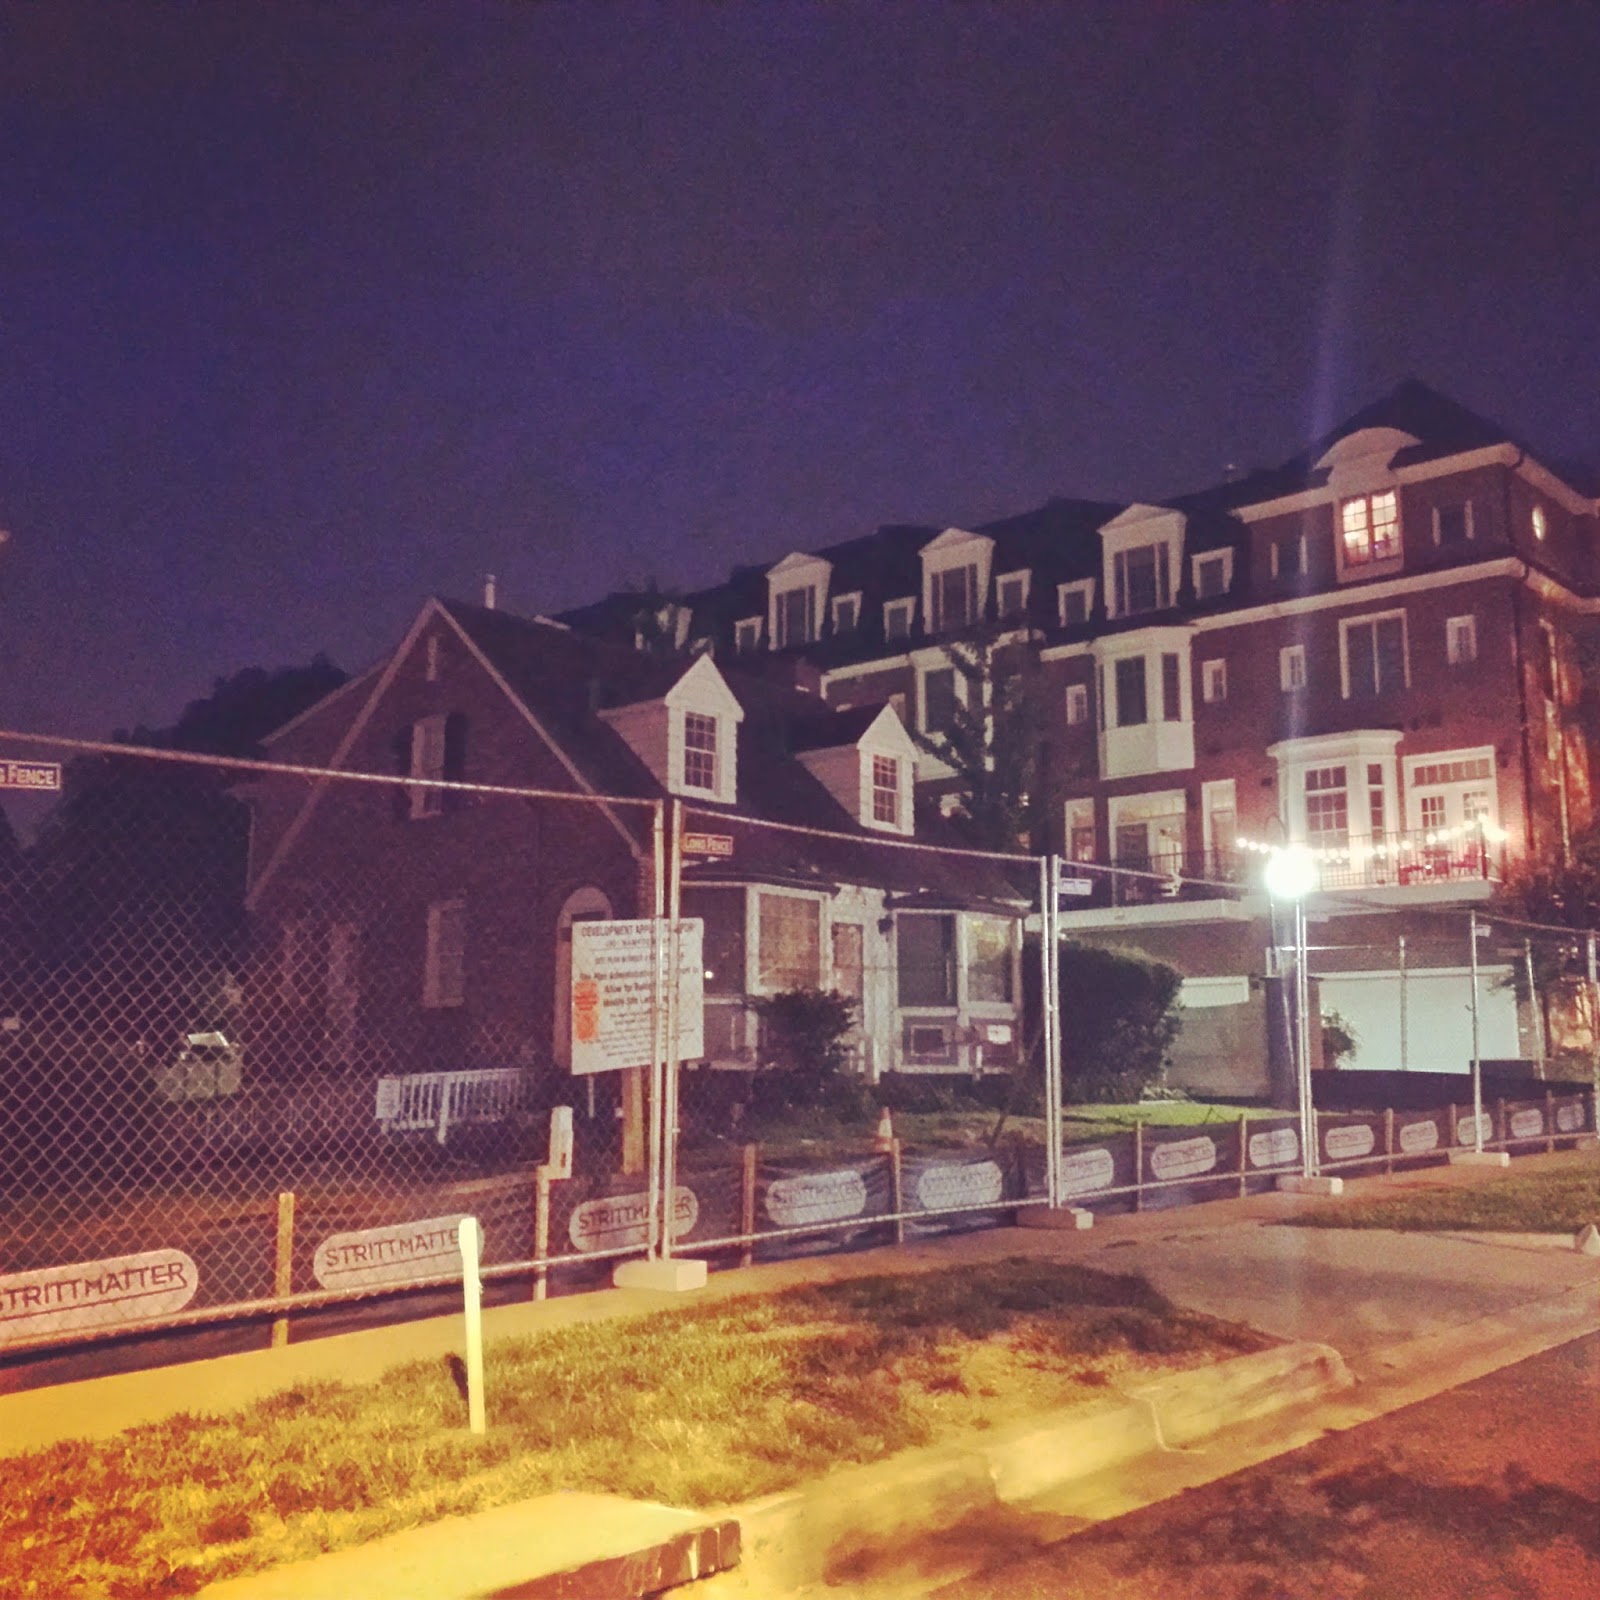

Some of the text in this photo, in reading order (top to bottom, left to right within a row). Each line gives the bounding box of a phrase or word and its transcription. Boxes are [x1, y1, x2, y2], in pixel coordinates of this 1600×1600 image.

[7, 764, 55, 785] FENCE
[326, 1229, 460, 1267] STRITTMATTE
[0, 1262, 188, 1312] TRITTMATTER
